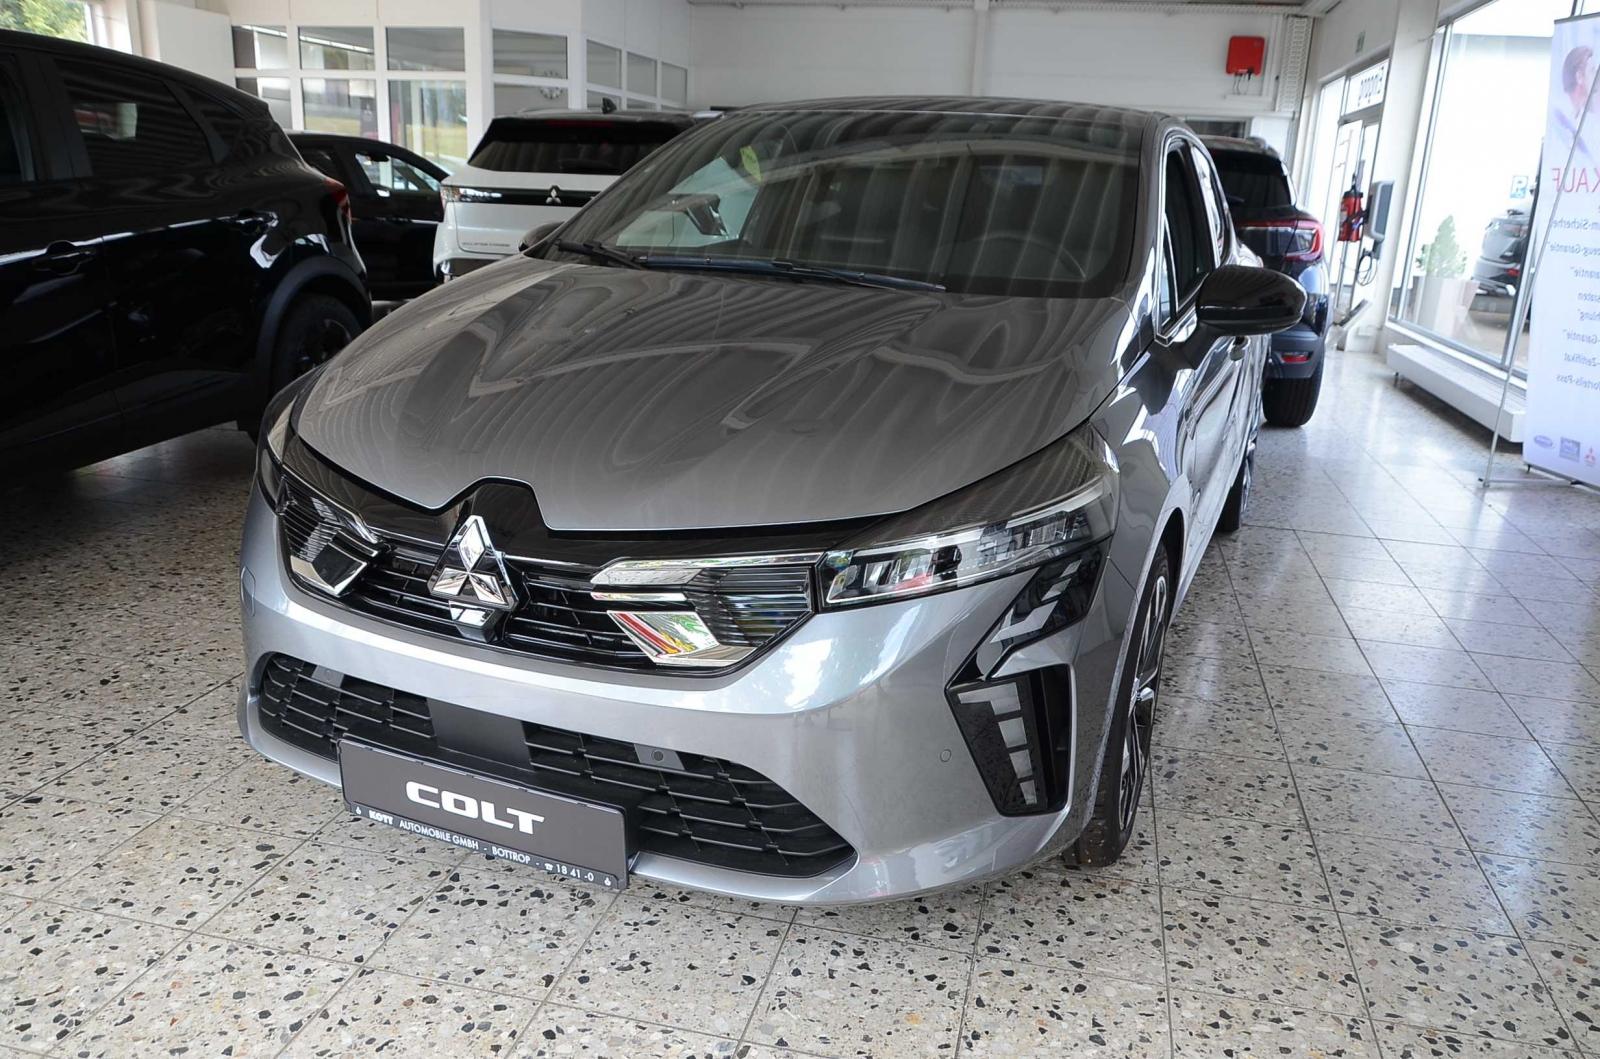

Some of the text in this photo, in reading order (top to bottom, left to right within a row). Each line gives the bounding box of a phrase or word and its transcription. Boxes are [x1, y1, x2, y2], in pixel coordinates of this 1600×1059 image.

[406, 781, 545, 835] COLT
[399, 820, 451, 842] AUTOMOBILE
[452, 834, 479, 850] GMBH
[491, 846, 531, 864] BOTTROP
